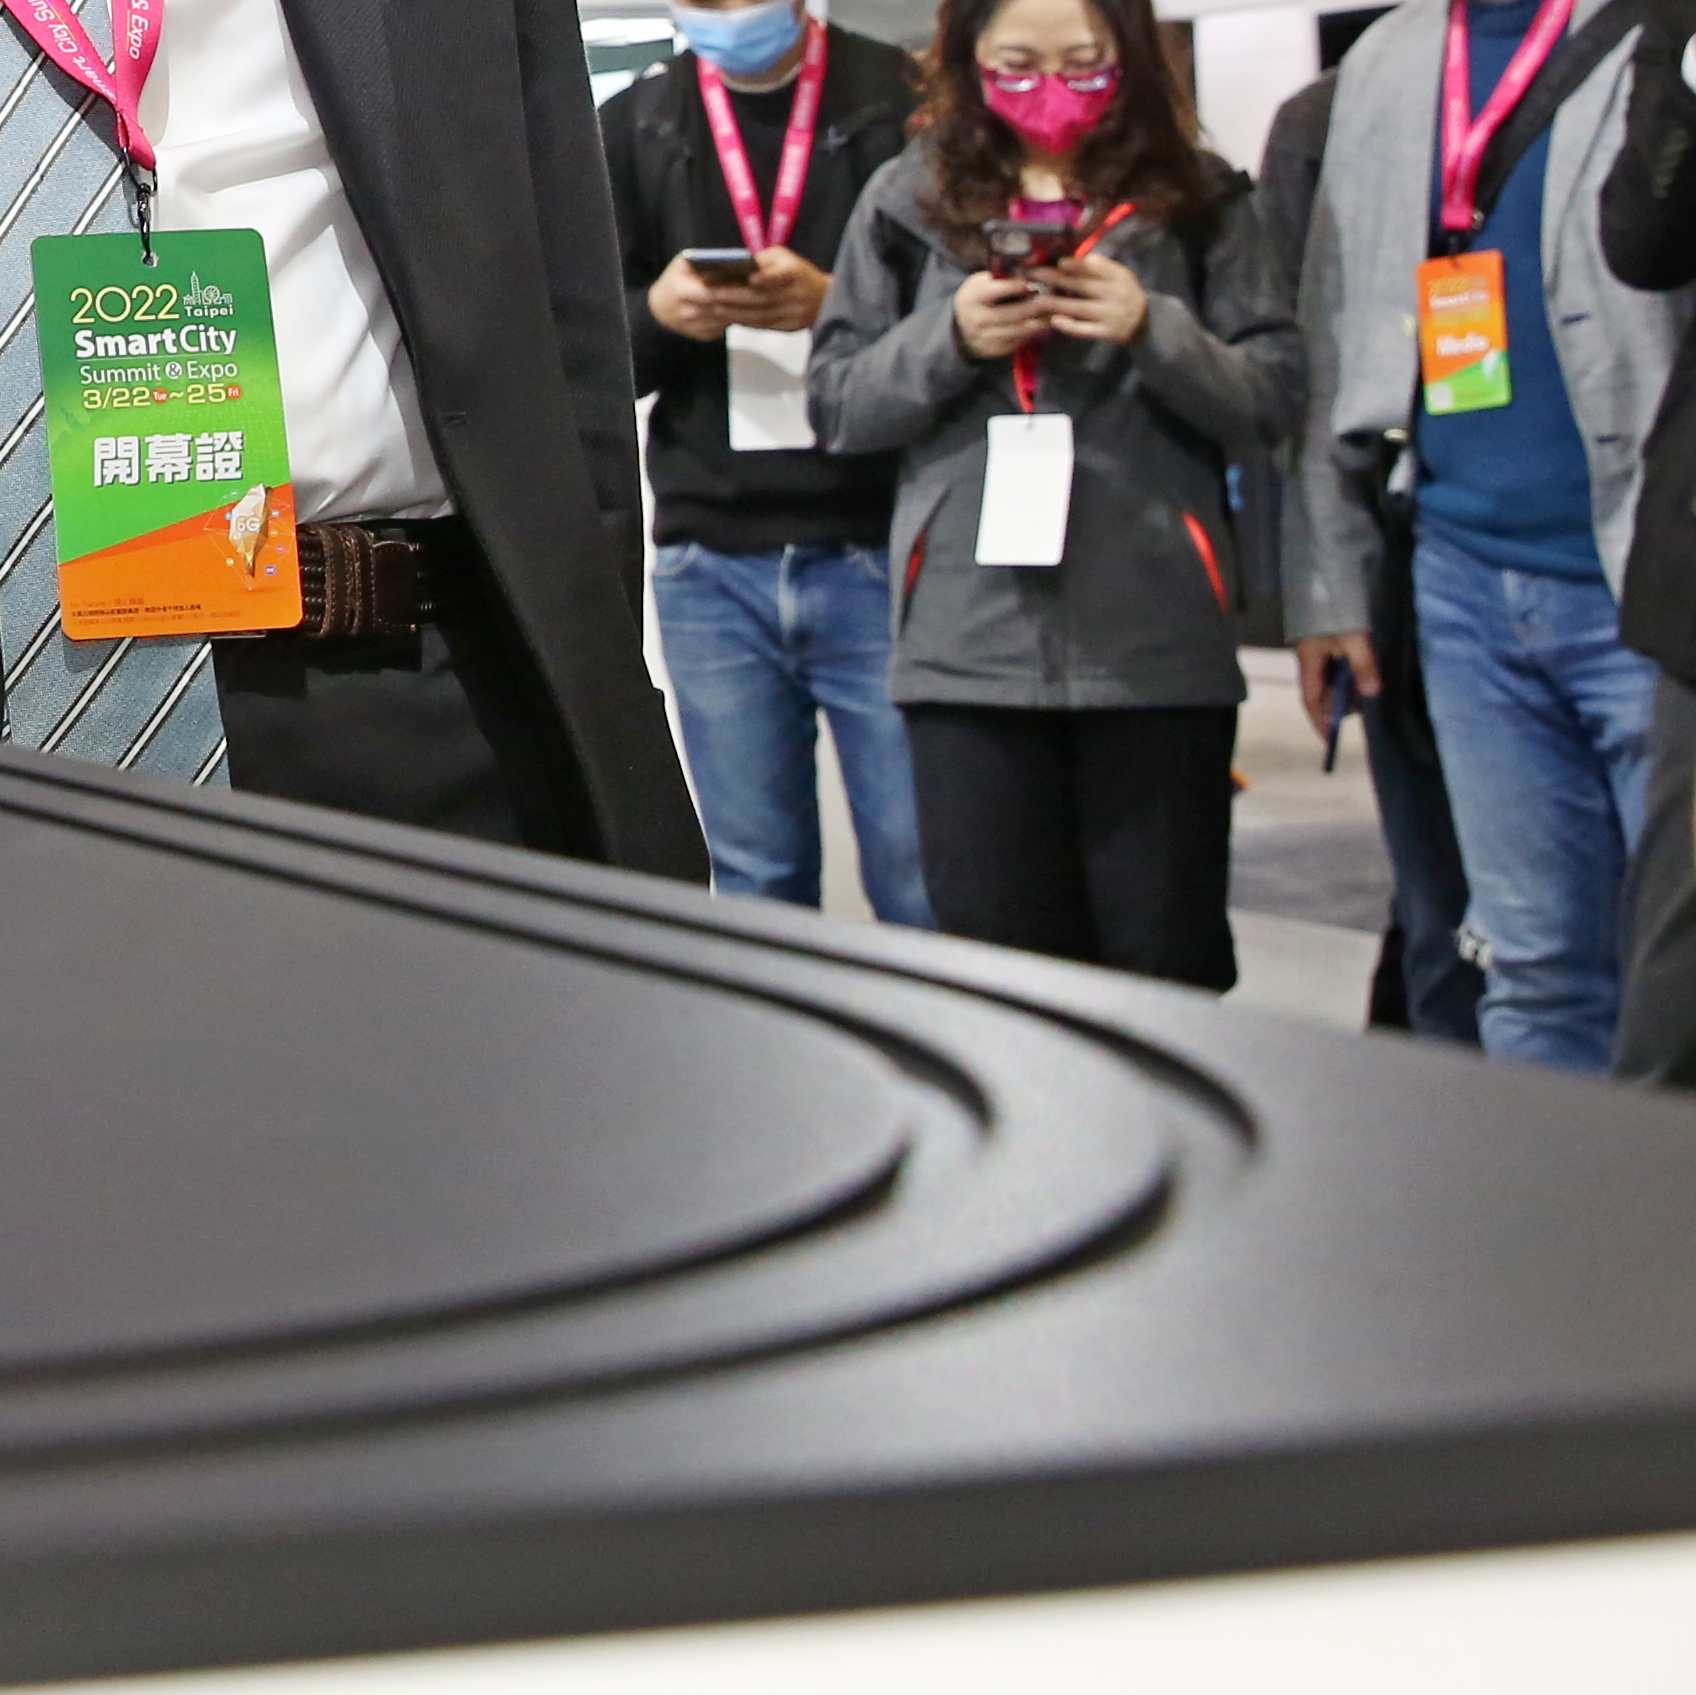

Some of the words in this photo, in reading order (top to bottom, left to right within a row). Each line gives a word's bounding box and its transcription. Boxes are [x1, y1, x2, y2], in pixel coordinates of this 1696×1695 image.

[49, 22, 79, 54] City
[127, 15, 150, 60] Expo
[70, 283, 181, 324] 2022
[184, 304, 234, 318] Taipei
[80, 362, 162, 385] Summit
[165, 361, 183, 380] &
[187, 360, 238, 382] Expo
[83, 386, 151, 410] 3/22
[153, 390, 169, 402] Tue
[187, 383, 226, 404] 25
[227, 387, 241, 397] Fri
[93, 430, 244, 487] 開幕證
[235, 515, 262, 533] 5G
